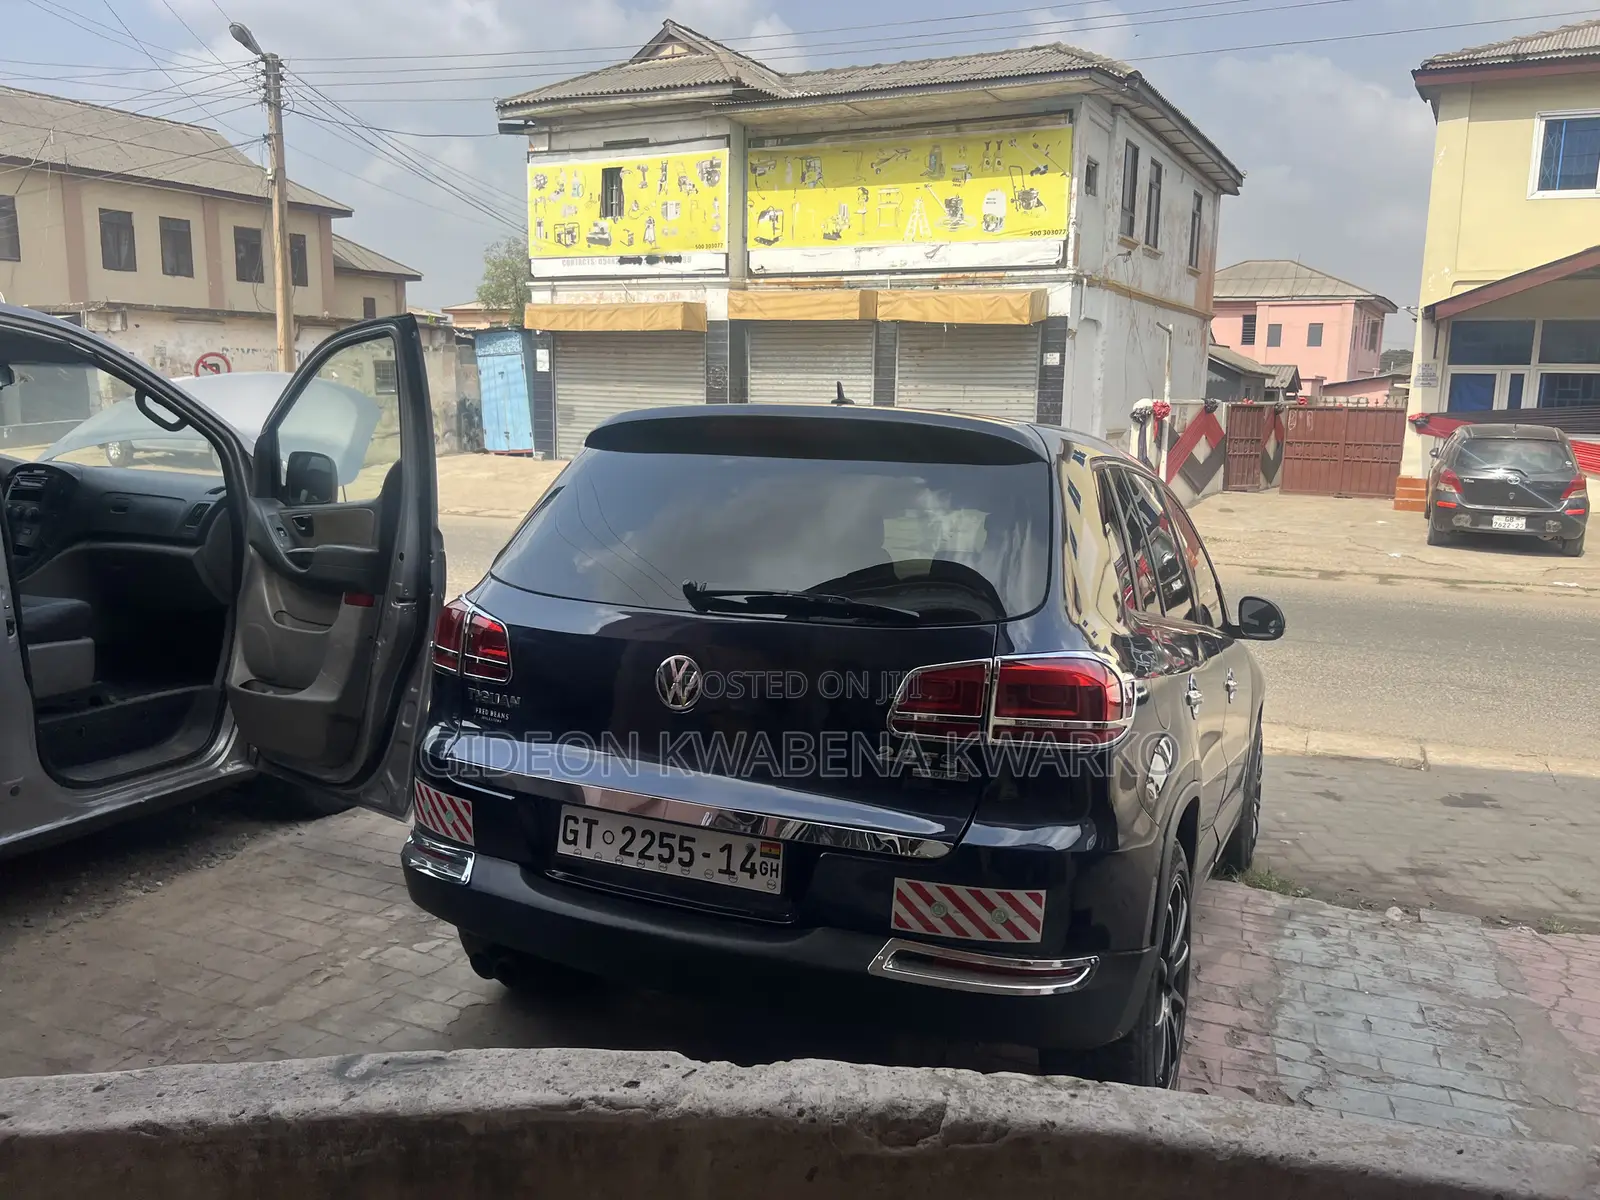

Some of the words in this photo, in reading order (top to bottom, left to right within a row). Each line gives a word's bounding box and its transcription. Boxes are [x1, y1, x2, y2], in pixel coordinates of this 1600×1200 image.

[475, 707, 489, 716] FRED
[490, 710, 510, 721] BEANS
[562, 814, 599, 849] GT
[618, 825, 758, 880] 2255-14
[759, 860, 780, 879] GH
